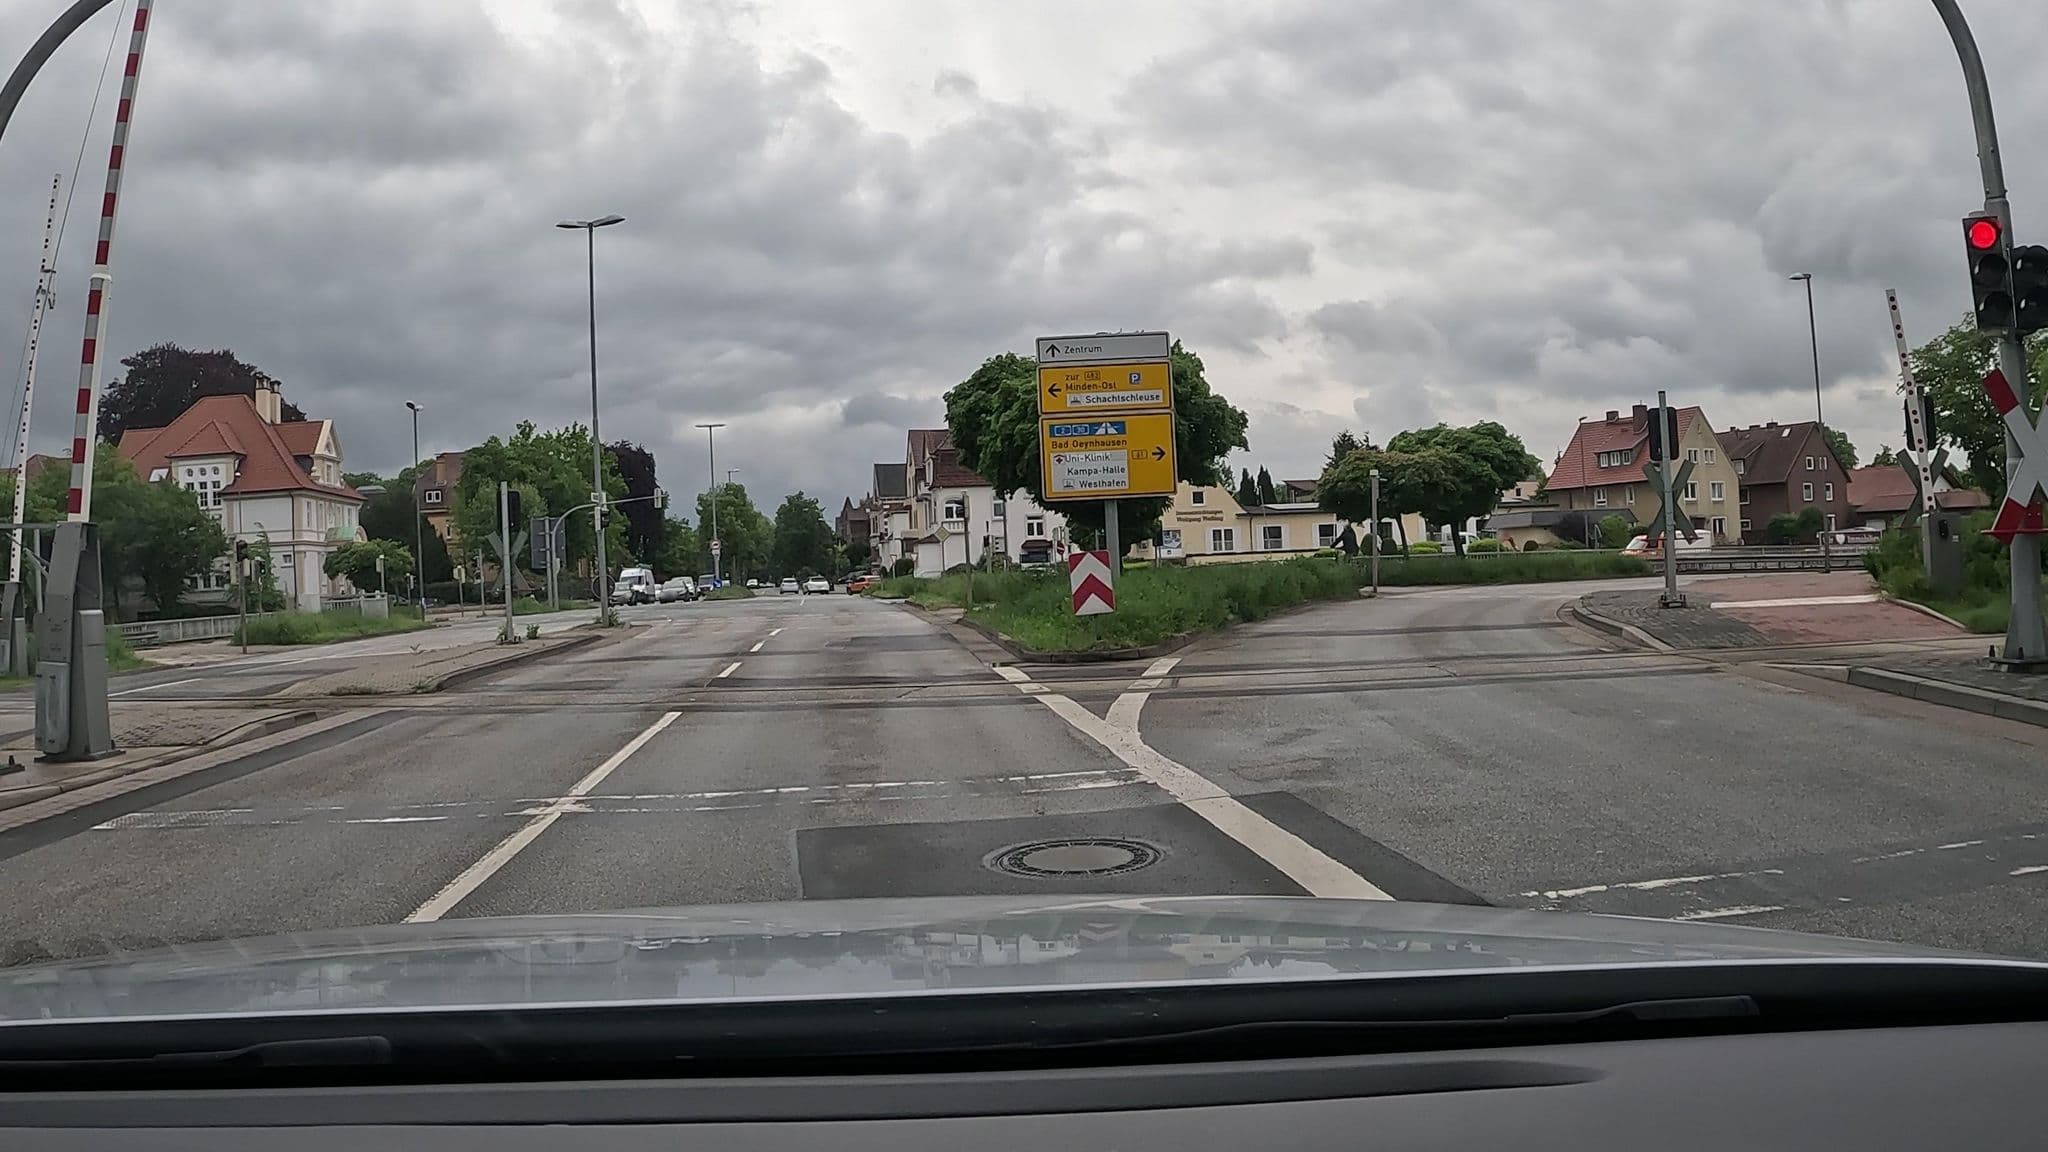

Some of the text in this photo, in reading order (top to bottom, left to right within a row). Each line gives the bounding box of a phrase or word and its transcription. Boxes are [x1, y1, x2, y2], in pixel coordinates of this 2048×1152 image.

[1064, 345, 1102, 354] Zentrum
[1130, 373, 1140, 383] P
[1065, 381, 1117, 391] Minden-Ost
[1085, 393, 1160, 404] Schachtschleuse
[1052, 439, 1127, 449] Bad Oeynhausen
[1065, 453, 1111, 463] Uni-Klinik
[1067, 466, 1126, 477] Kampa-Halle
[1079, 480, 1127, 488] Westhafen
